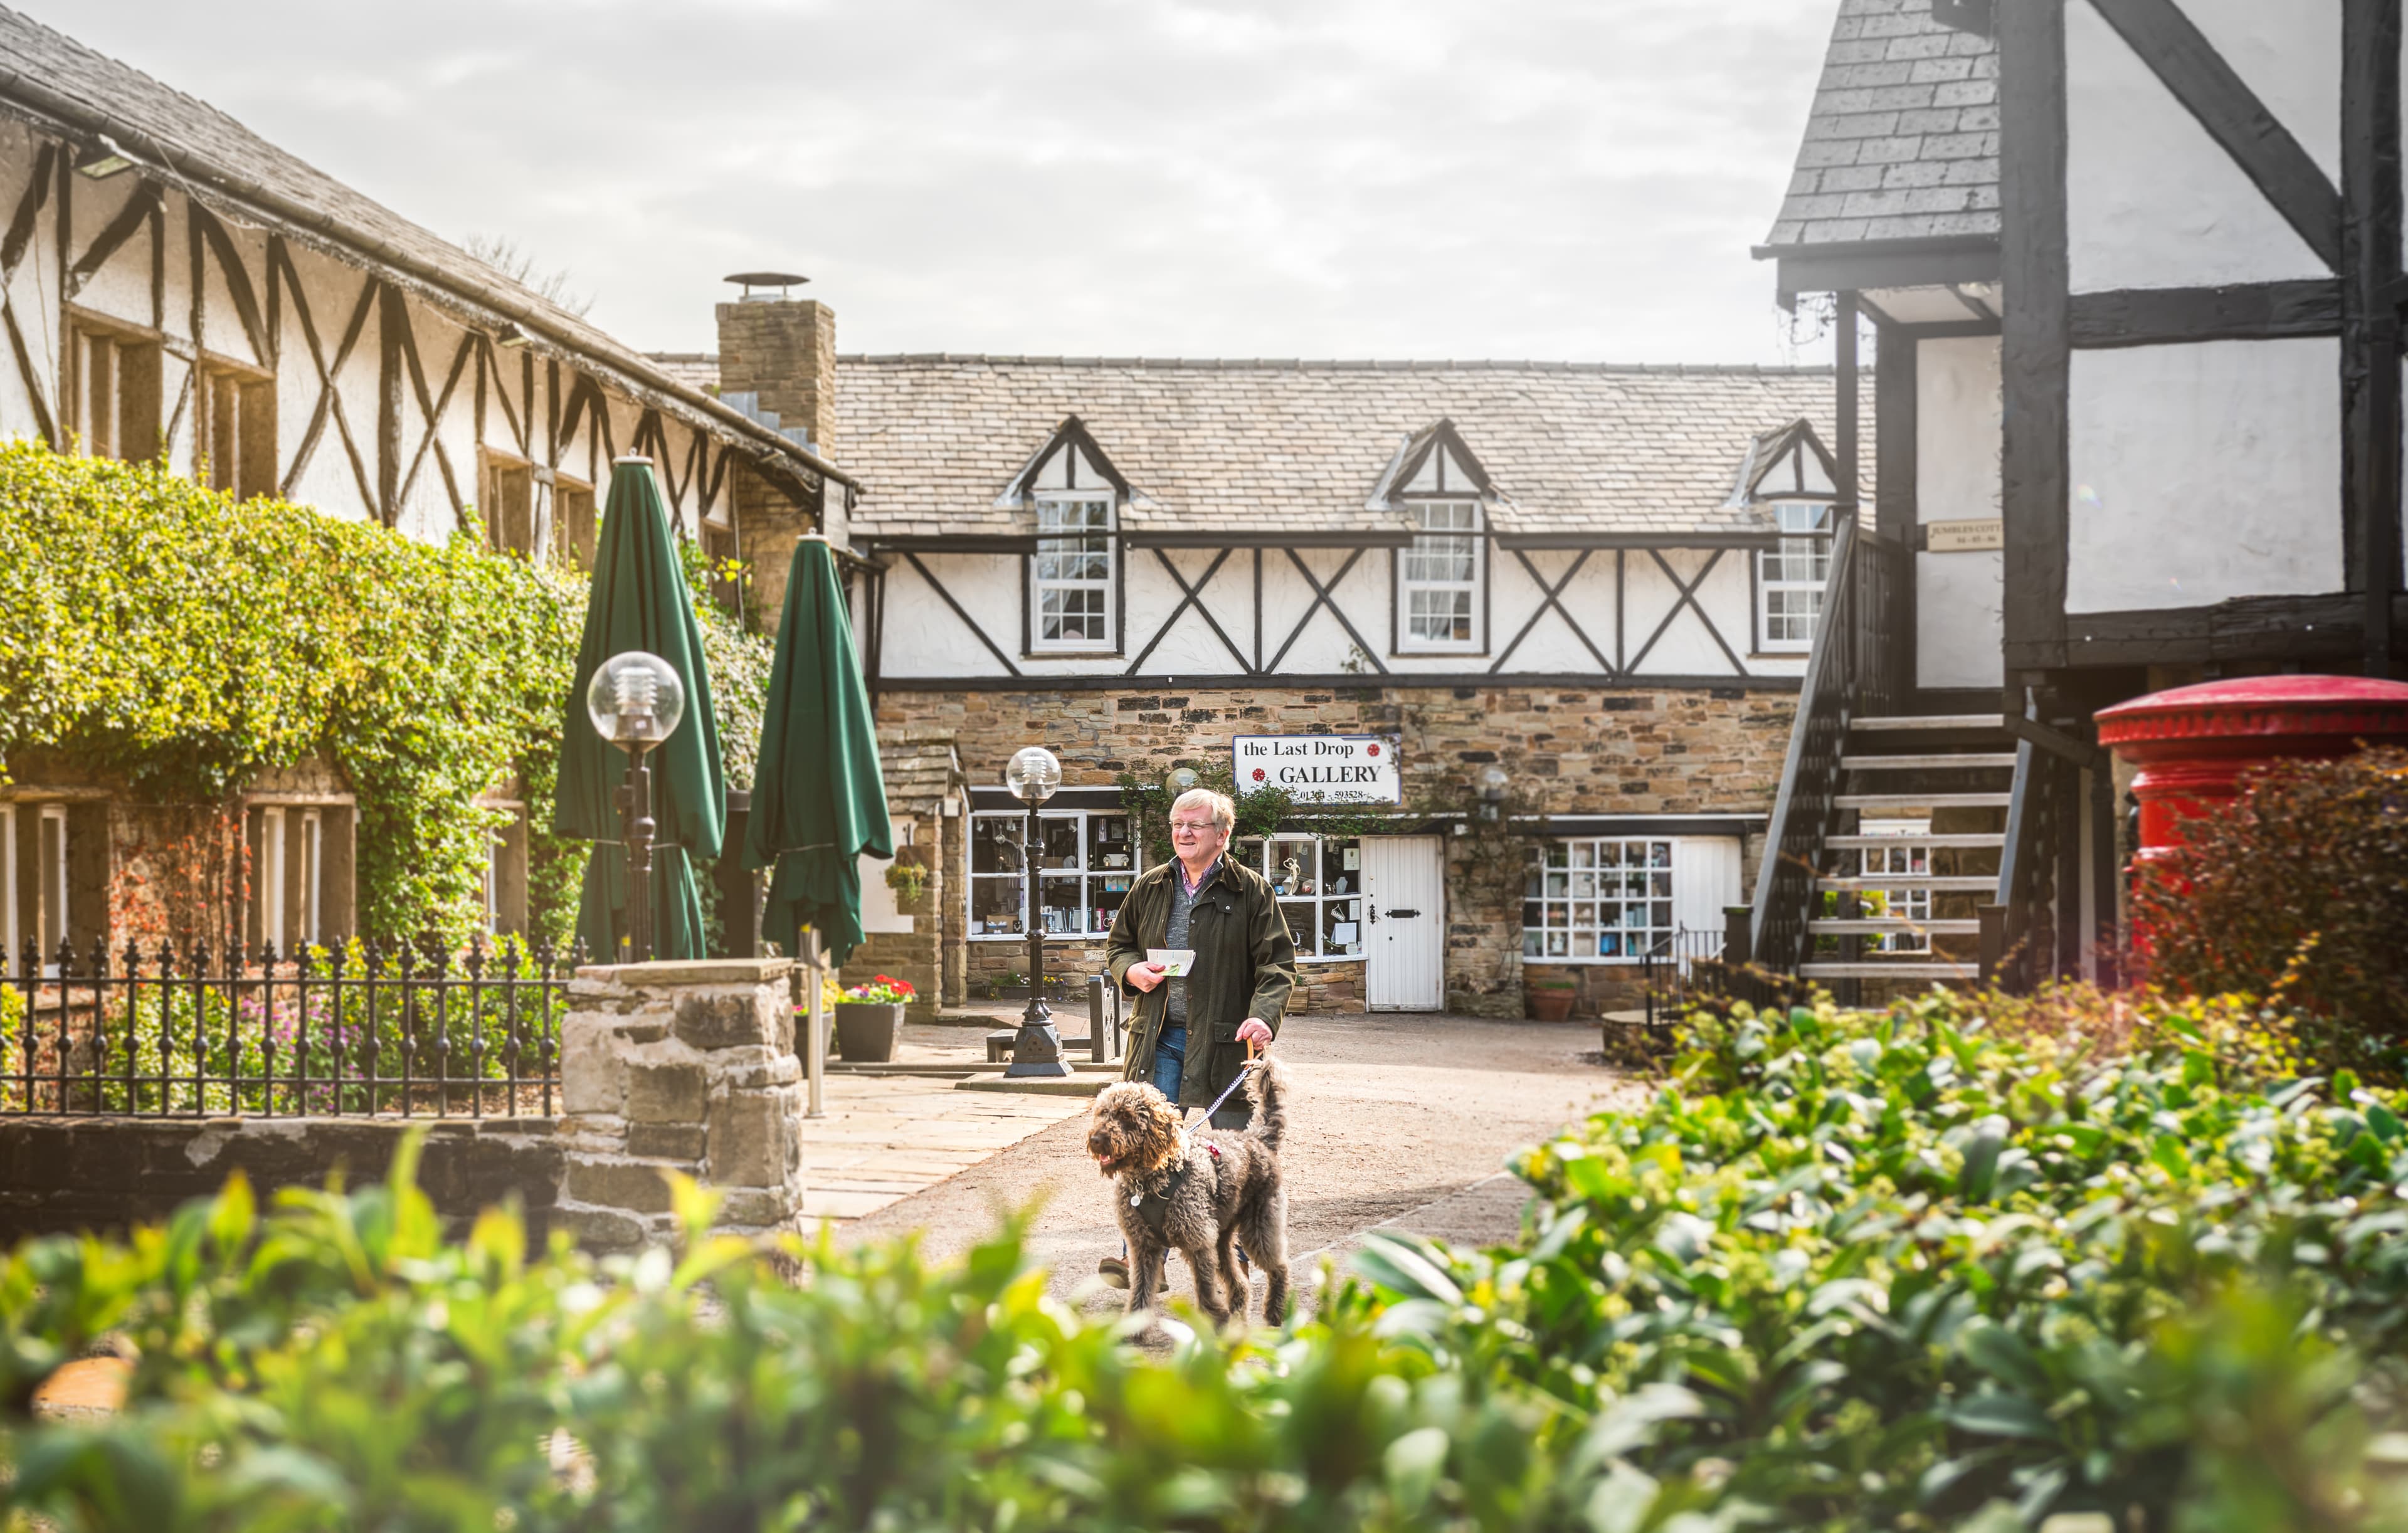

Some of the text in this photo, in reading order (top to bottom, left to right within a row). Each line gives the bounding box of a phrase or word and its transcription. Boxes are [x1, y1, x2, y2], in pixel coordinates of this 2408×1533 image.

[1975, 524, 2003, 533] COTT
[1244, 741, 1354, 759] the Last Drop
[1279, 766, 1381, 783] GALLERY
[1300, 790, 1325, 799] 0124
[1334, 790, 1363, 799] 593528
